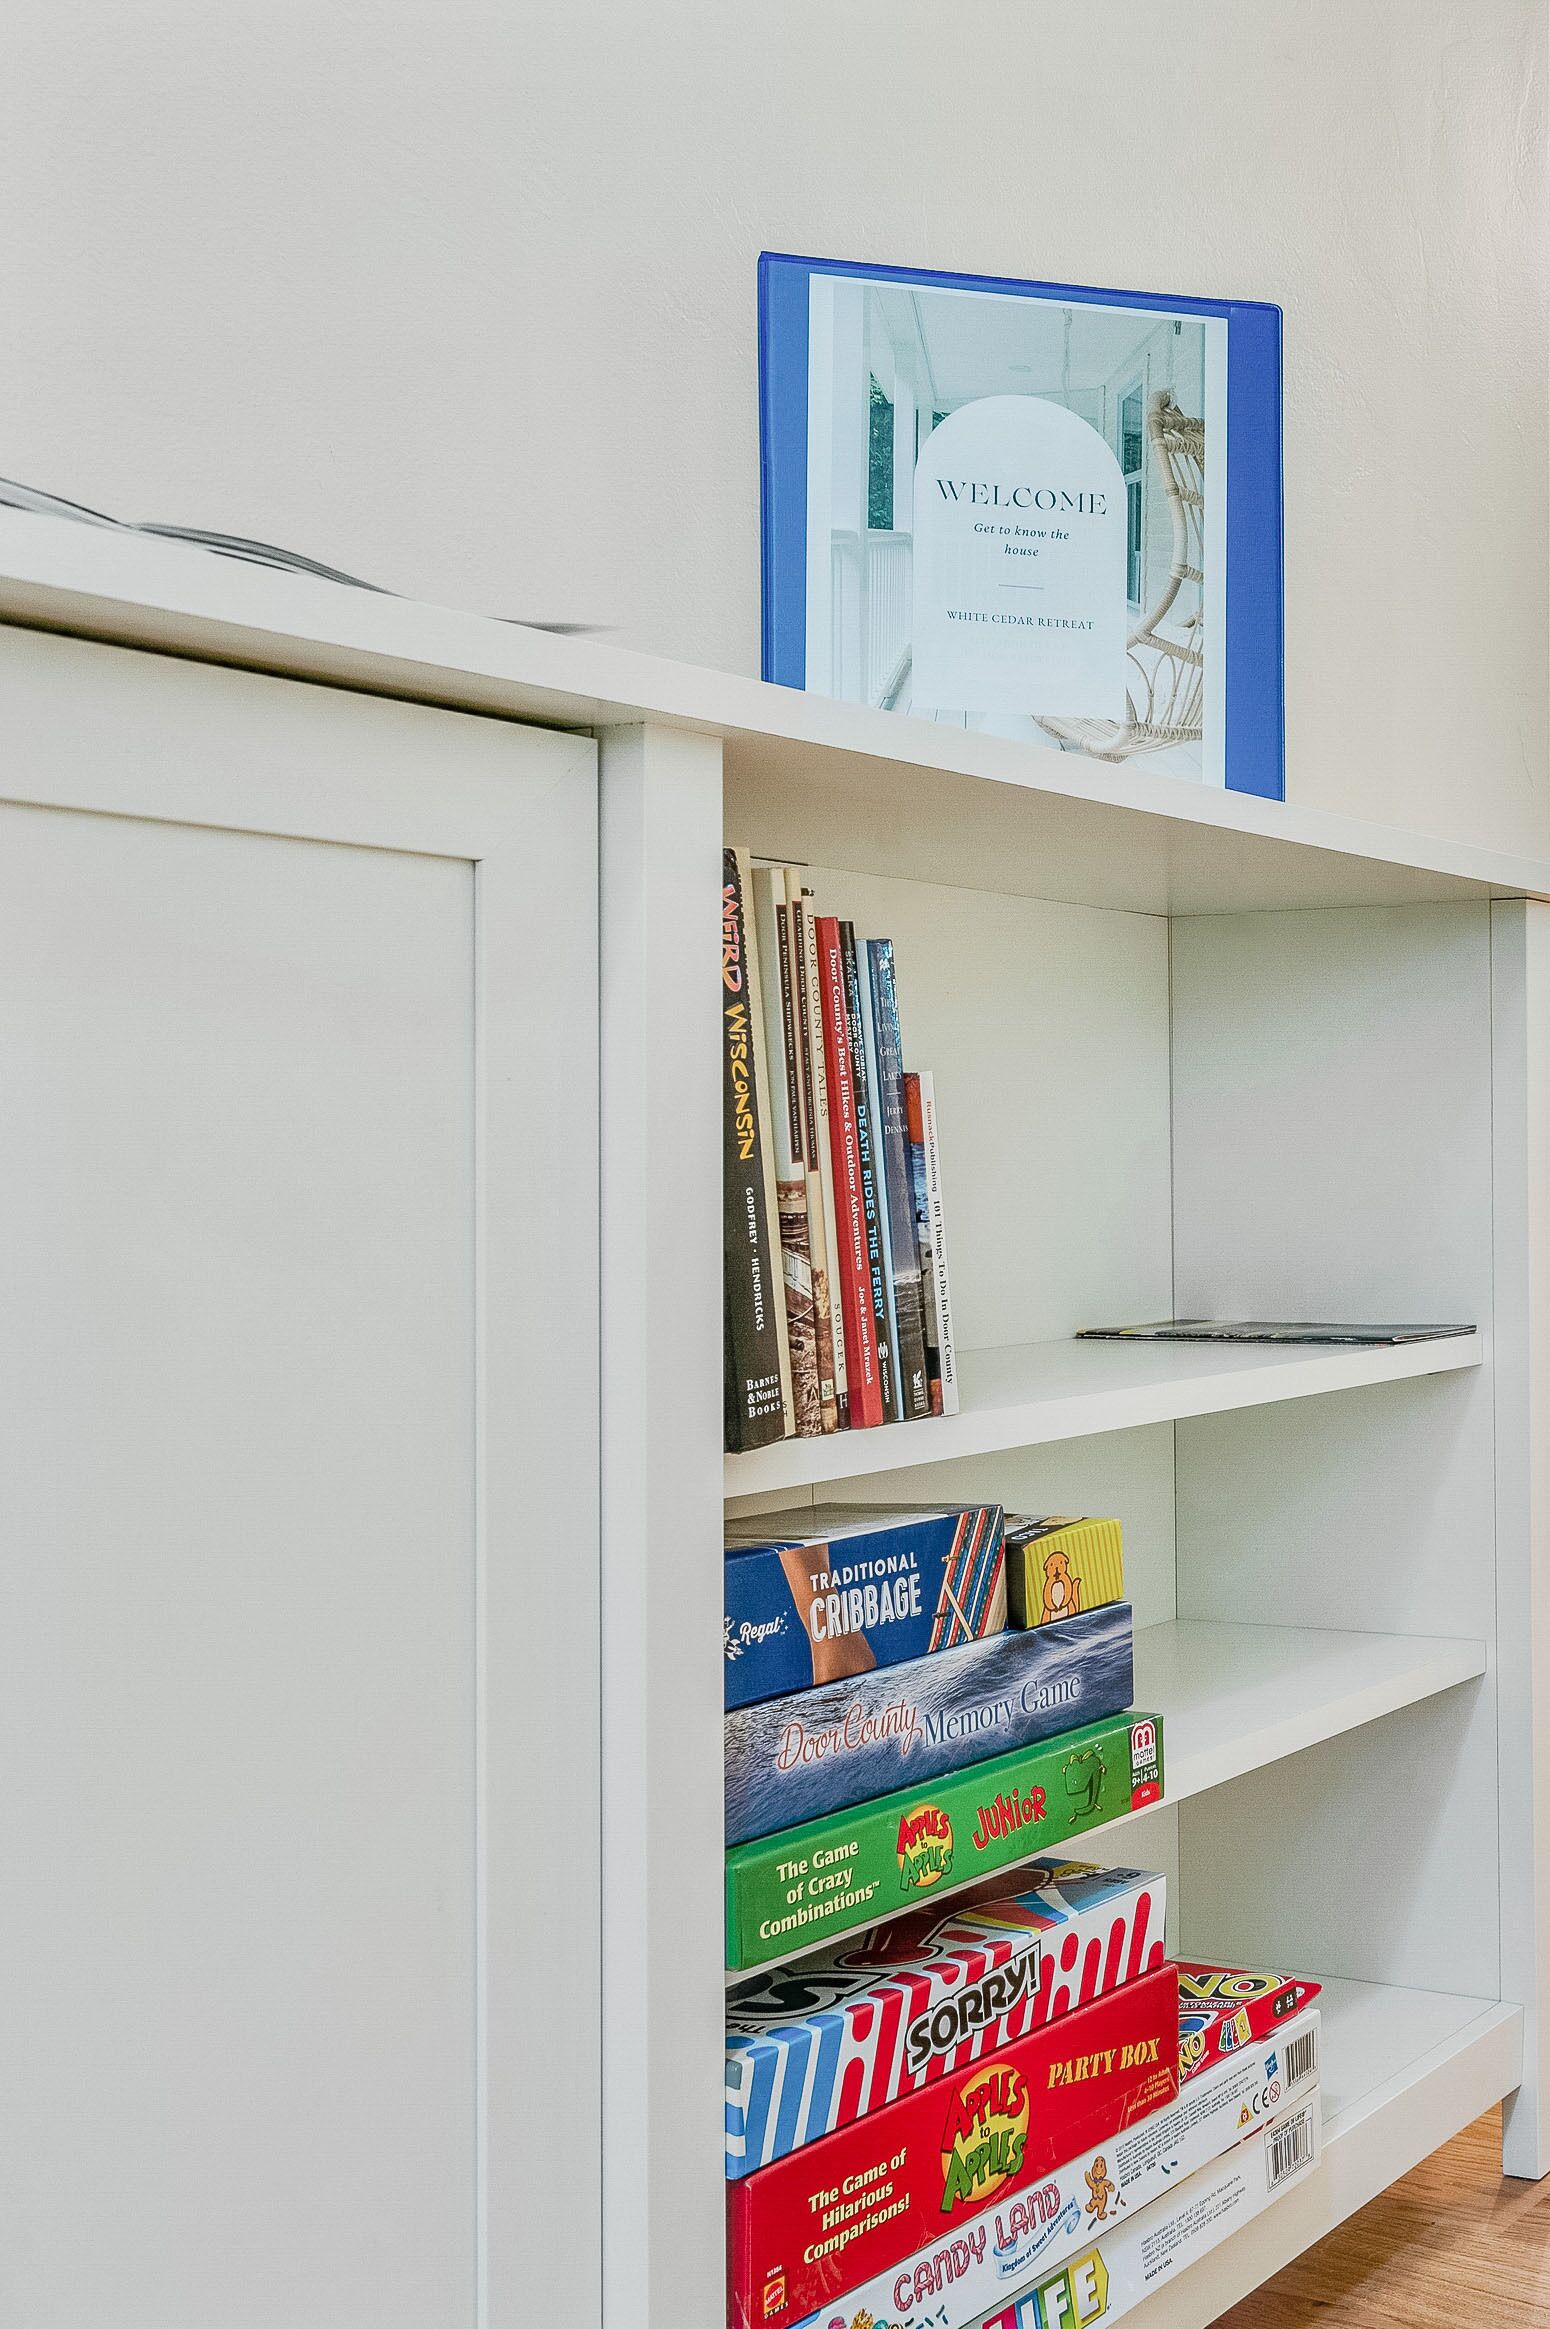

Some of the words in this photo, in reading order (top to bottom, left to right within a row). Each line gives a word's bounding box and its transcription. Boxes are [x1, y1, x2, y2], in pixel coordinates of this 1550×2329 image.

[936, 479, 1107, 515] WELCOME
[974, 523, 995, 534] Get
[999, 525, 1011, 535] to
[1014, 525, 1047, 538] know
[1051, 529, 1070, 540] the
[1004, 544, 1039, 557] house
[947, 610, 988, 622] WHITE
[991, 613, 1034, 626] CEDAR
[1037, 617, 1095, 630] RETREAT
[807, 914, 817, 968] DOOR
[829, 949, 838, 983] Door
[811, 976, 823, 1054] COUNTY
[833, 986, 845, 1044] County's
[838, 1048, 847, 1076] Best
[853, 1041, 861, 1078] COUNTY
[818, 1061, 828, 1117] TALES
[840, 1080, 850, 1118] Hikes
[844, 1122, 852, 1132] &
[857, 1105, 870, 1162] DEATH
[884, 1124, 909, 1135] DENNIS
[845, 1135, 855, 1191] Outdoor
[862, 1169, 875, 1220] RIDES
[933, 1201, 941, 1219] 101
[745, 1187, 758, 1245] GODFREY
[850, 1195, 863, 1271] Adventures
[868, 1226, 879, 1260] THE
[935, 1223, 946, 1259] Things
[937, 1262, 946, 1278] To
[940, 1280, 948, 1295] Do
[751, 1257, 765, 1331] HENDRICKS
[858, 1287, 866, 1305] Joe
[860, 1306, 867, 1314] &
[872, 1267, 885, 1319] FERRY
[941, 1299, 948, 1311] In
[834, 1304, 845, 1371] SOUCEK
[861, 1316, 870, 1345] Janet
[942, 1314, 950, 1341] Door
[746, 1374, 779, 1390] BARNES
[863, 1347, 874, 1385] Mrazek
[882, 1360, 890, 1403] WISCONSIN
[944, 1344, 953, 1385] County
[747, 1388, 780, 1405] &NOBLE
[748, 1401, 781, 1419] BOOKS
[809, 1552, 918, 1592] TRADITIONAL
[809, 1573, 922, 1643] CRIBBAGE
[739, 1616, 781, 1646] Regal
[777, 1722, 841, 1770] Door
[842, 1699, 922, 1755] County
[922, 1696, 1014, 1749] Memory
[1020, 1676, 1082, 1715] Game
[1132, 1777, 1140, 1787] 9+
[1143, 1769, 1158, 1783] 4-10
[896, 1809, 950, 1854] APPLES
[920, 1840, 928, 1849] to
[776, 1857, 809, 1883] The
[812, 1841, 859, 1870] Game
[900, 1845, 953, 1891] APPLES
[786, 1883, 806, 1905] of
[808, 1866, 854, 1897] Crazy
[909, 1947, 1039, 2068] SORRY!
[1047, 2048, 1117, 2089] PARTY
[1119, 2037, 1161, 2070] BOX
[940, 2068, 1028, 2154] APPLES
[979, 2126, 991, 2139] to
[808, 2185, 839, 2214] The
[842, 2159, 888, 2196] Game
[890, 2147, 908, 2170] of
[940, 2127, 1028, 2214] APPLES
[822, 2181, 894, 2231] Hilarious
[803, 2192, 911, 2265] Comparisons!
[894, 2224, 987, 2312] CANDY
[995, 2183, 1061, 2250] LAND
[1002, 2255, 1026, 2273] Kingdom
[1025, 2247, 1032, 2258] of
[1032, 2232, 1047, 2253] Sweet
[1144, 2268, 1158, 2281] MADE
[764, 2301, 789, 2320] GAMES
[765, 2286, 784, 2305] MATTEL
[988, 2259, 1101, 2329] IFE
